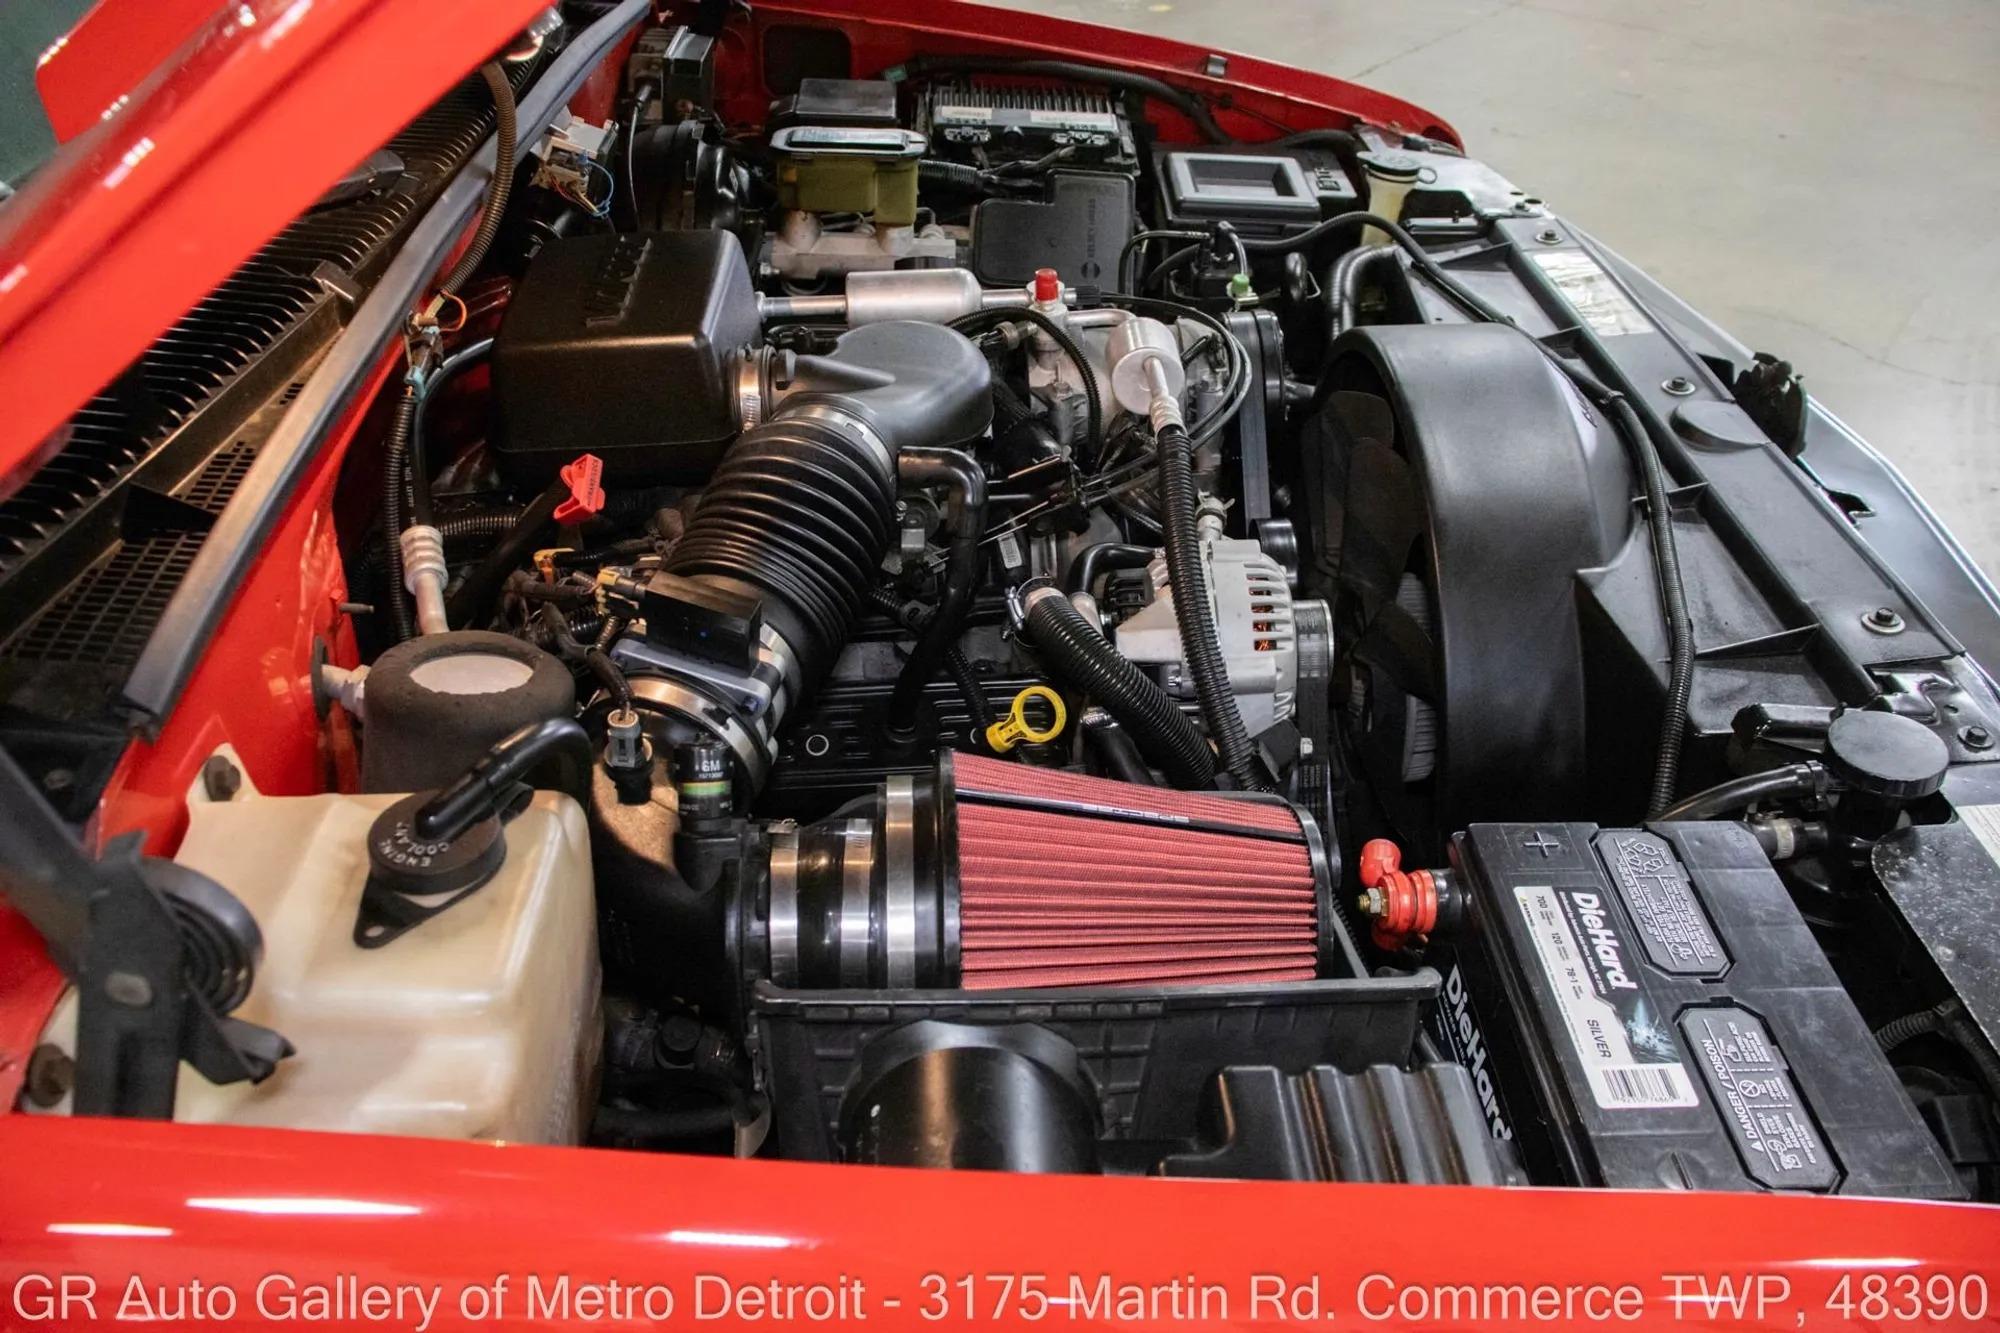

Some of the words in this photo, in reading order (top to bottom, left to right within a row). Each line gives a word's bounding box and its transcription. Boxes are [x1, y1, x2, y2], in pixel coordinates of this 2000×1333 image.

[702, 760, 720, 771] GM
[379, 839, 432, 867] ENGINE
[393, 822, 450, 855] COOLANT
[1551, 932, 1563, 945] 120
[1571, 891, 1638, 990] DieHard
[1587, 1019, 1612, 1058] SILVER
[1701, 1038, 1730, 1079] POISON
[1727, 1090, 1758, 1138] DANGER
